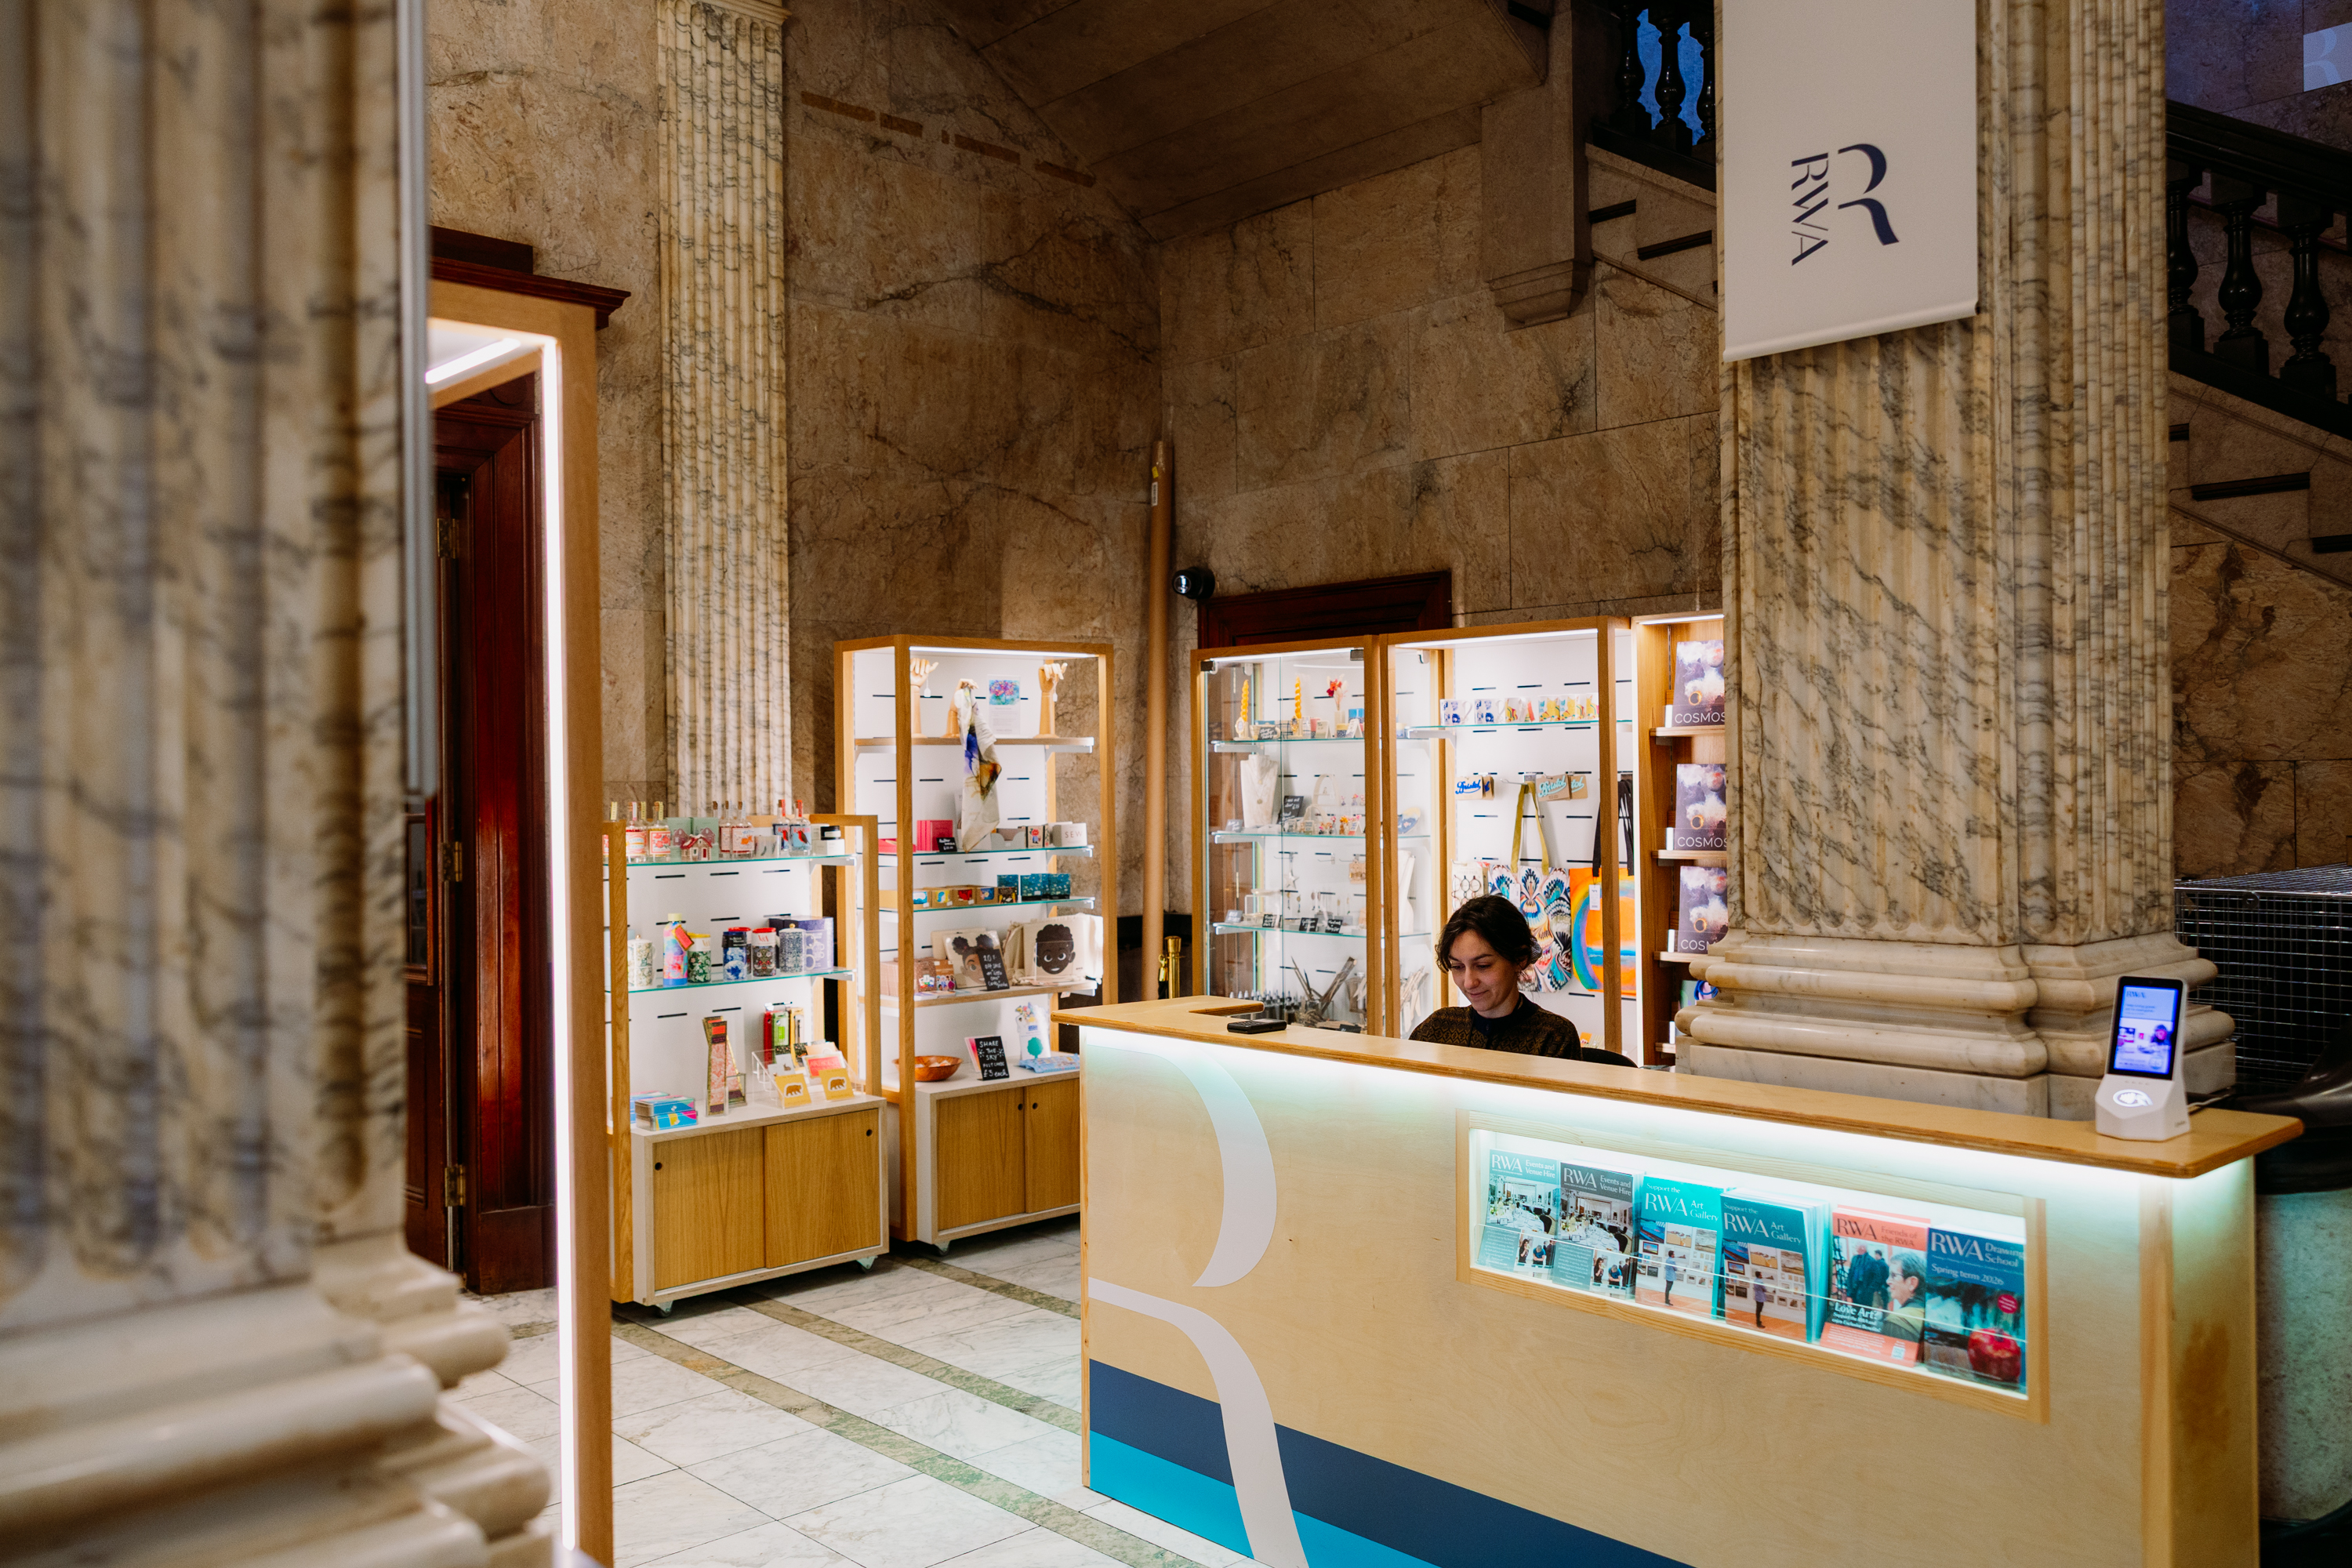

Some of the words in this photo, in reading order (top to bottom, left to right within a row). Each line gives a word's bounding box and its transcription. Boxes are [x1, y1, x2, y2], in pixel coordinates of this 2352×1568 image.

[1791, 152, 1829, 267] RWA
[1675, 712, 1725, 724] COSMOS
[1455, 779, 1481, 794] Bristol
[1538, 775, 1566, 798] Bristol
[1492, 1154, 1523, 1173] RWA
[1526, 1160, 1544, 1169] Events
[1525, 1167, 1543, 1176] Venue
[1544, 1170, 1555, 1178] Hire
[1564, 1167, 1597, 1189] RWA
[1600, 1175, 1619, 1185] Events
[1646, 1182, 1669, 1192] Support
[1600, 1182, 1617, 1192] Venue
[1619, 1187, 1632, 1196] Hire
[1646, 1192, 1687, 1217] RWA
[1691, 1200, 1704, 1210] Art
[1724, 1203, 1747, 1212] Support
[1690, 1209, 1719, 1223] Gallery
[1724, 1212, 1769, 1238] RWA
[1771, 1221, 1784, 1232] Art
[1837, 1218, 1877, 1240] RWA
[1882, 1226, 1907, 1237] Friends
[1771, 1230, 1801, 1246] Gallery
[1895, 1236, 1915, 1247] RWA
[1931, 1232, 1984, 1261] RWA
[1985, 1242, 2025, 1261] Drawing
[1984, 1253, 2019, 1267] School
[1931, 1263, 1959, 1279] Spring
[1959, 1270, 1980, 1280] term
[1835, 1301, 1857, 1316] Love
